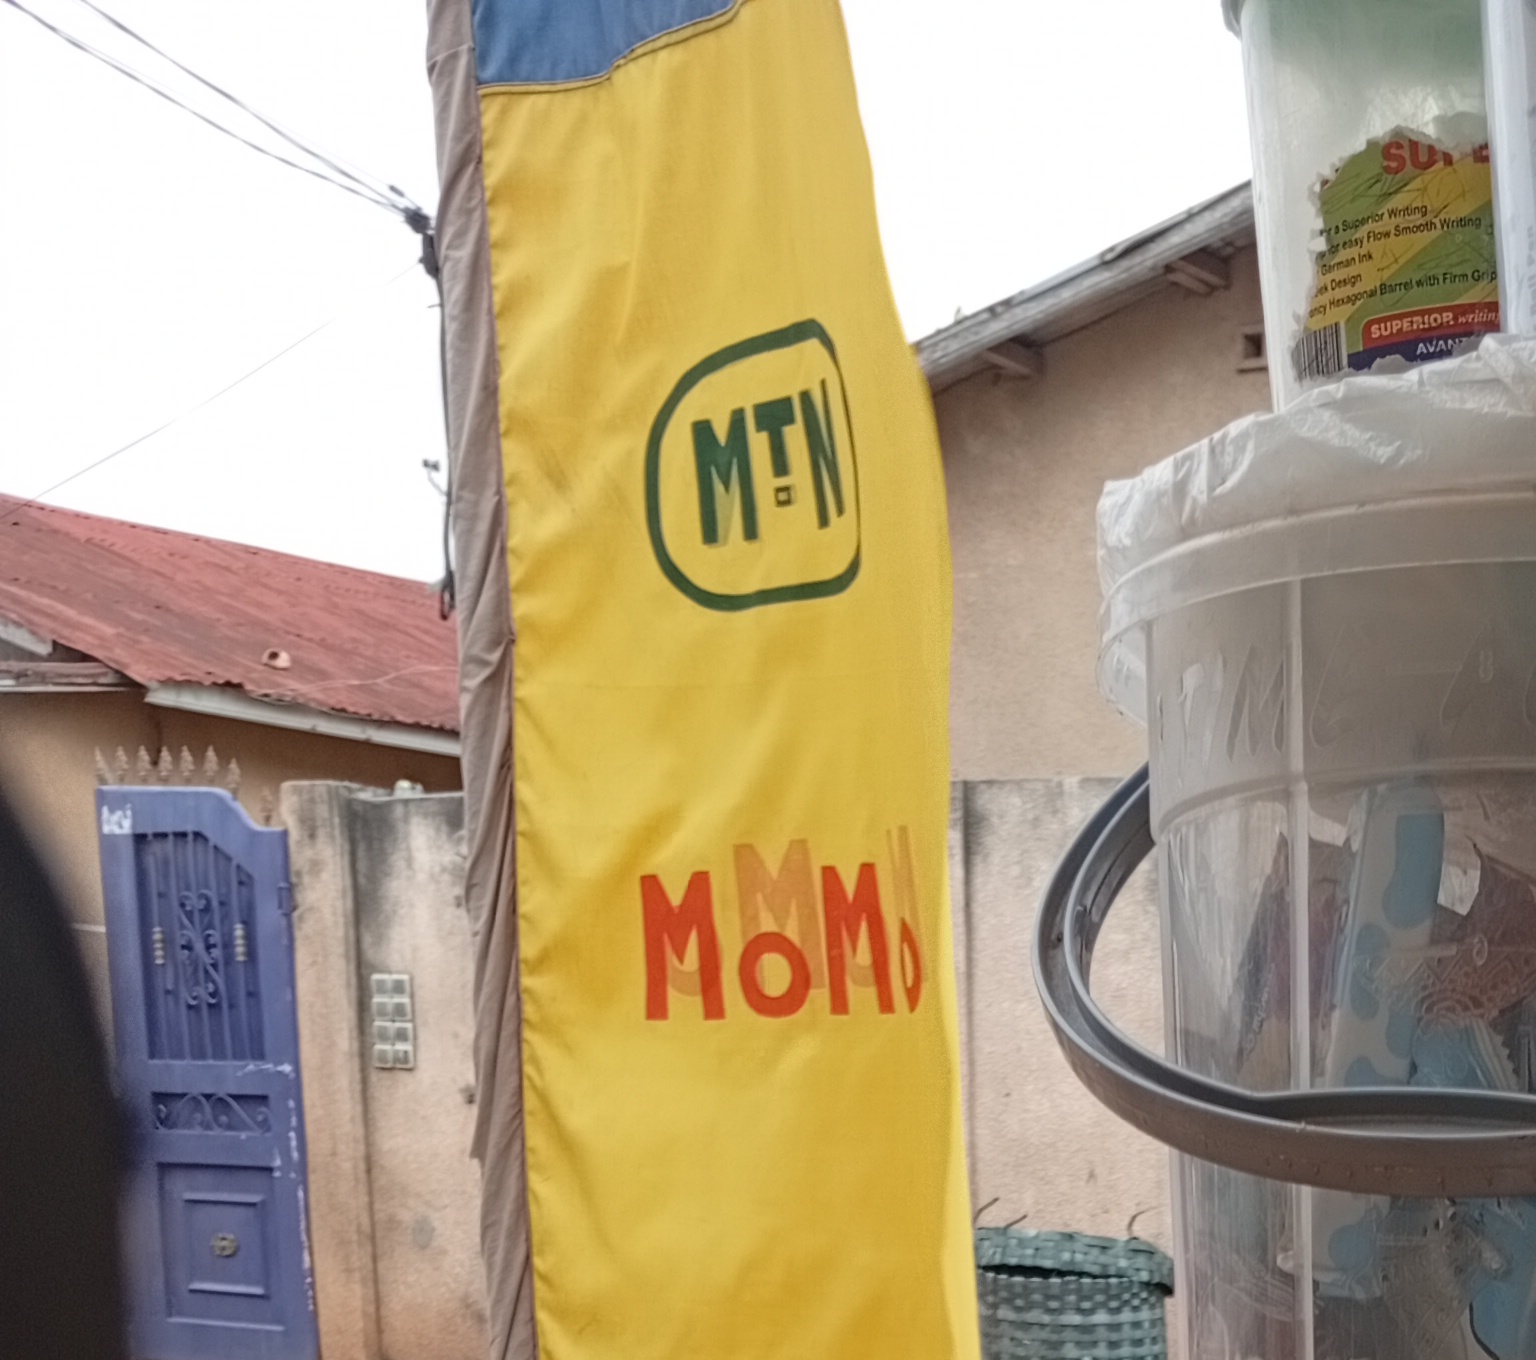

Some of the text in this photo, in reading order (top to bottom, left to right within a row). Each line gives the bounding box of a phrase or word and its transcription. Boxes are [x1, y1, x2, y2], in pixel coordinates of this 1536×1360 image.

[1342, 211, 1385, 233] Superior
[1387, 204, 1428, 222] Writing
[1342, 235, 1364, 252] easy
[1367, 228, 1391, 245] Flow
[1394, 219, 1437, 237] Smooth
[1439, 215, 1482, 231] Writing
[1320, 250, 1374, 276] German Ink
[1329, 286, 1378, 311] Hexagonal
[1379, 277, 1414, 296] Barrel
[1415, 275, 1440, 289] with
[1442, 269, 1469, 285] Firm
[1471, 267, 1498, 284] Grip
[1331, 273, 1363, 291] Design
[1370, 311, 1455, 339] SUPERIOR
[690, 378, 845, 548] MTN
